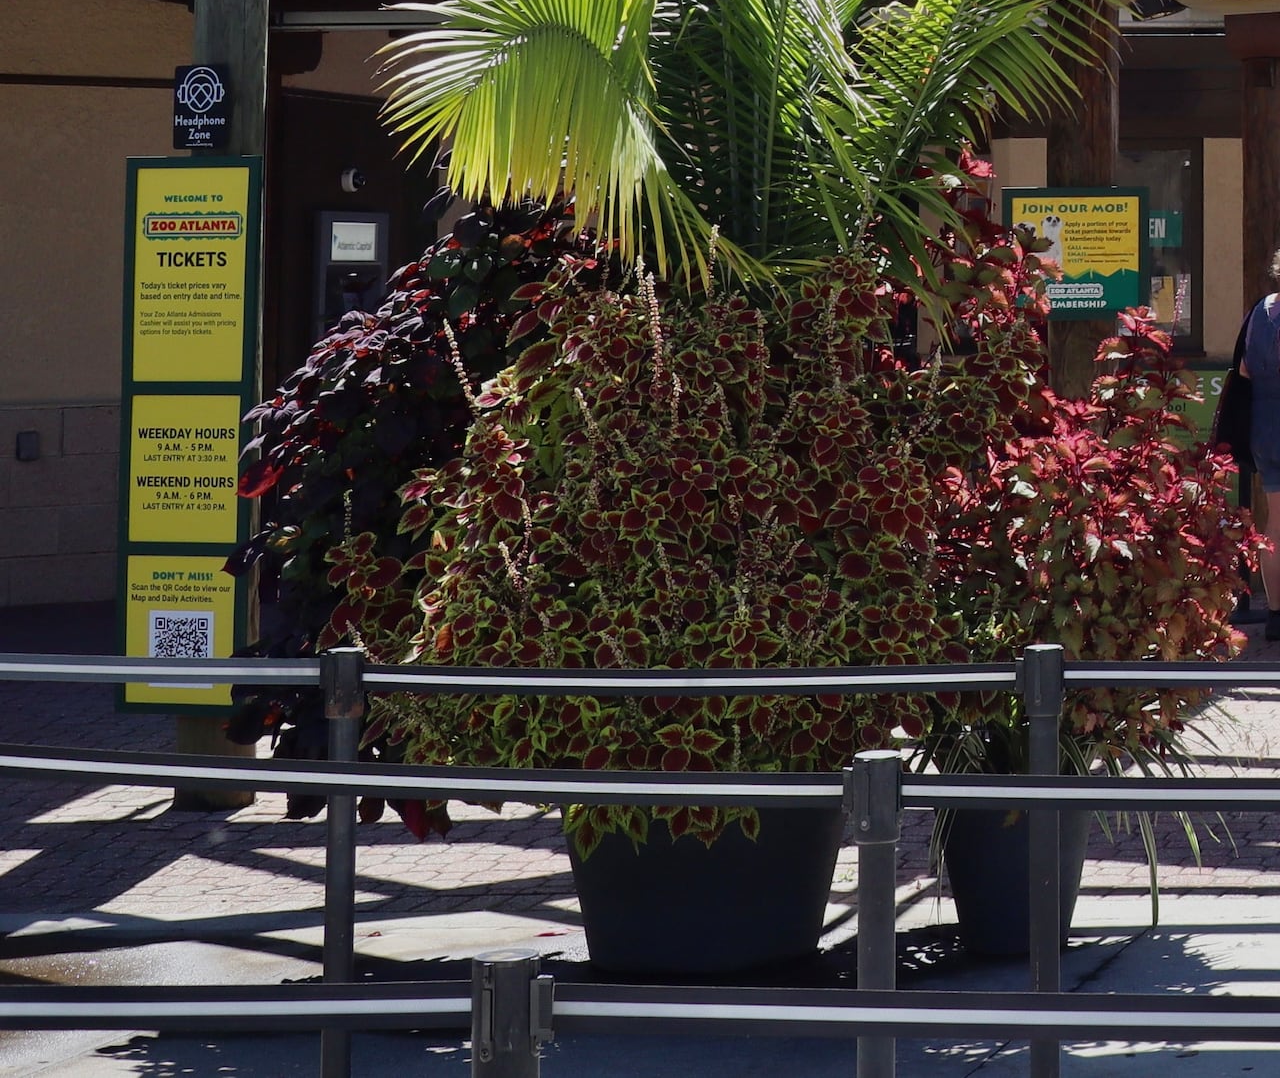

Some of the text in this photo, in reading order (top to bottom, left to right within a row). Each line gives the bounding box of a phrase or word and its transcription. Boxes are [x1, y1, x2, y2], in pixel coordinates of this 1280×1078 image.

[175, 114, 225, 129] Headphone
[188, 128, 210, 139] Zone
[1022, 202, 1128, 214] JOIN OUR MOB!
[151, 221, 236, 231] ZOO ATLANTA
[1149, 218, 1166, 238] EN
[157, 252, 227, 267] TICKETS
[141, 282, 166, 290] Today's
[174, 293, 190, 301] entry
[1167, 402, 1186, 412] oo!
[138, 428, 235, 439] WEEKDAY HOURS
[137, 476, 234, 488] WEEKEND HOURS
[197, 492, 213, 500] P.M.
[153, 572, 213, 581] DON'T MISS!
[162, 595, 179, 603] Daily
